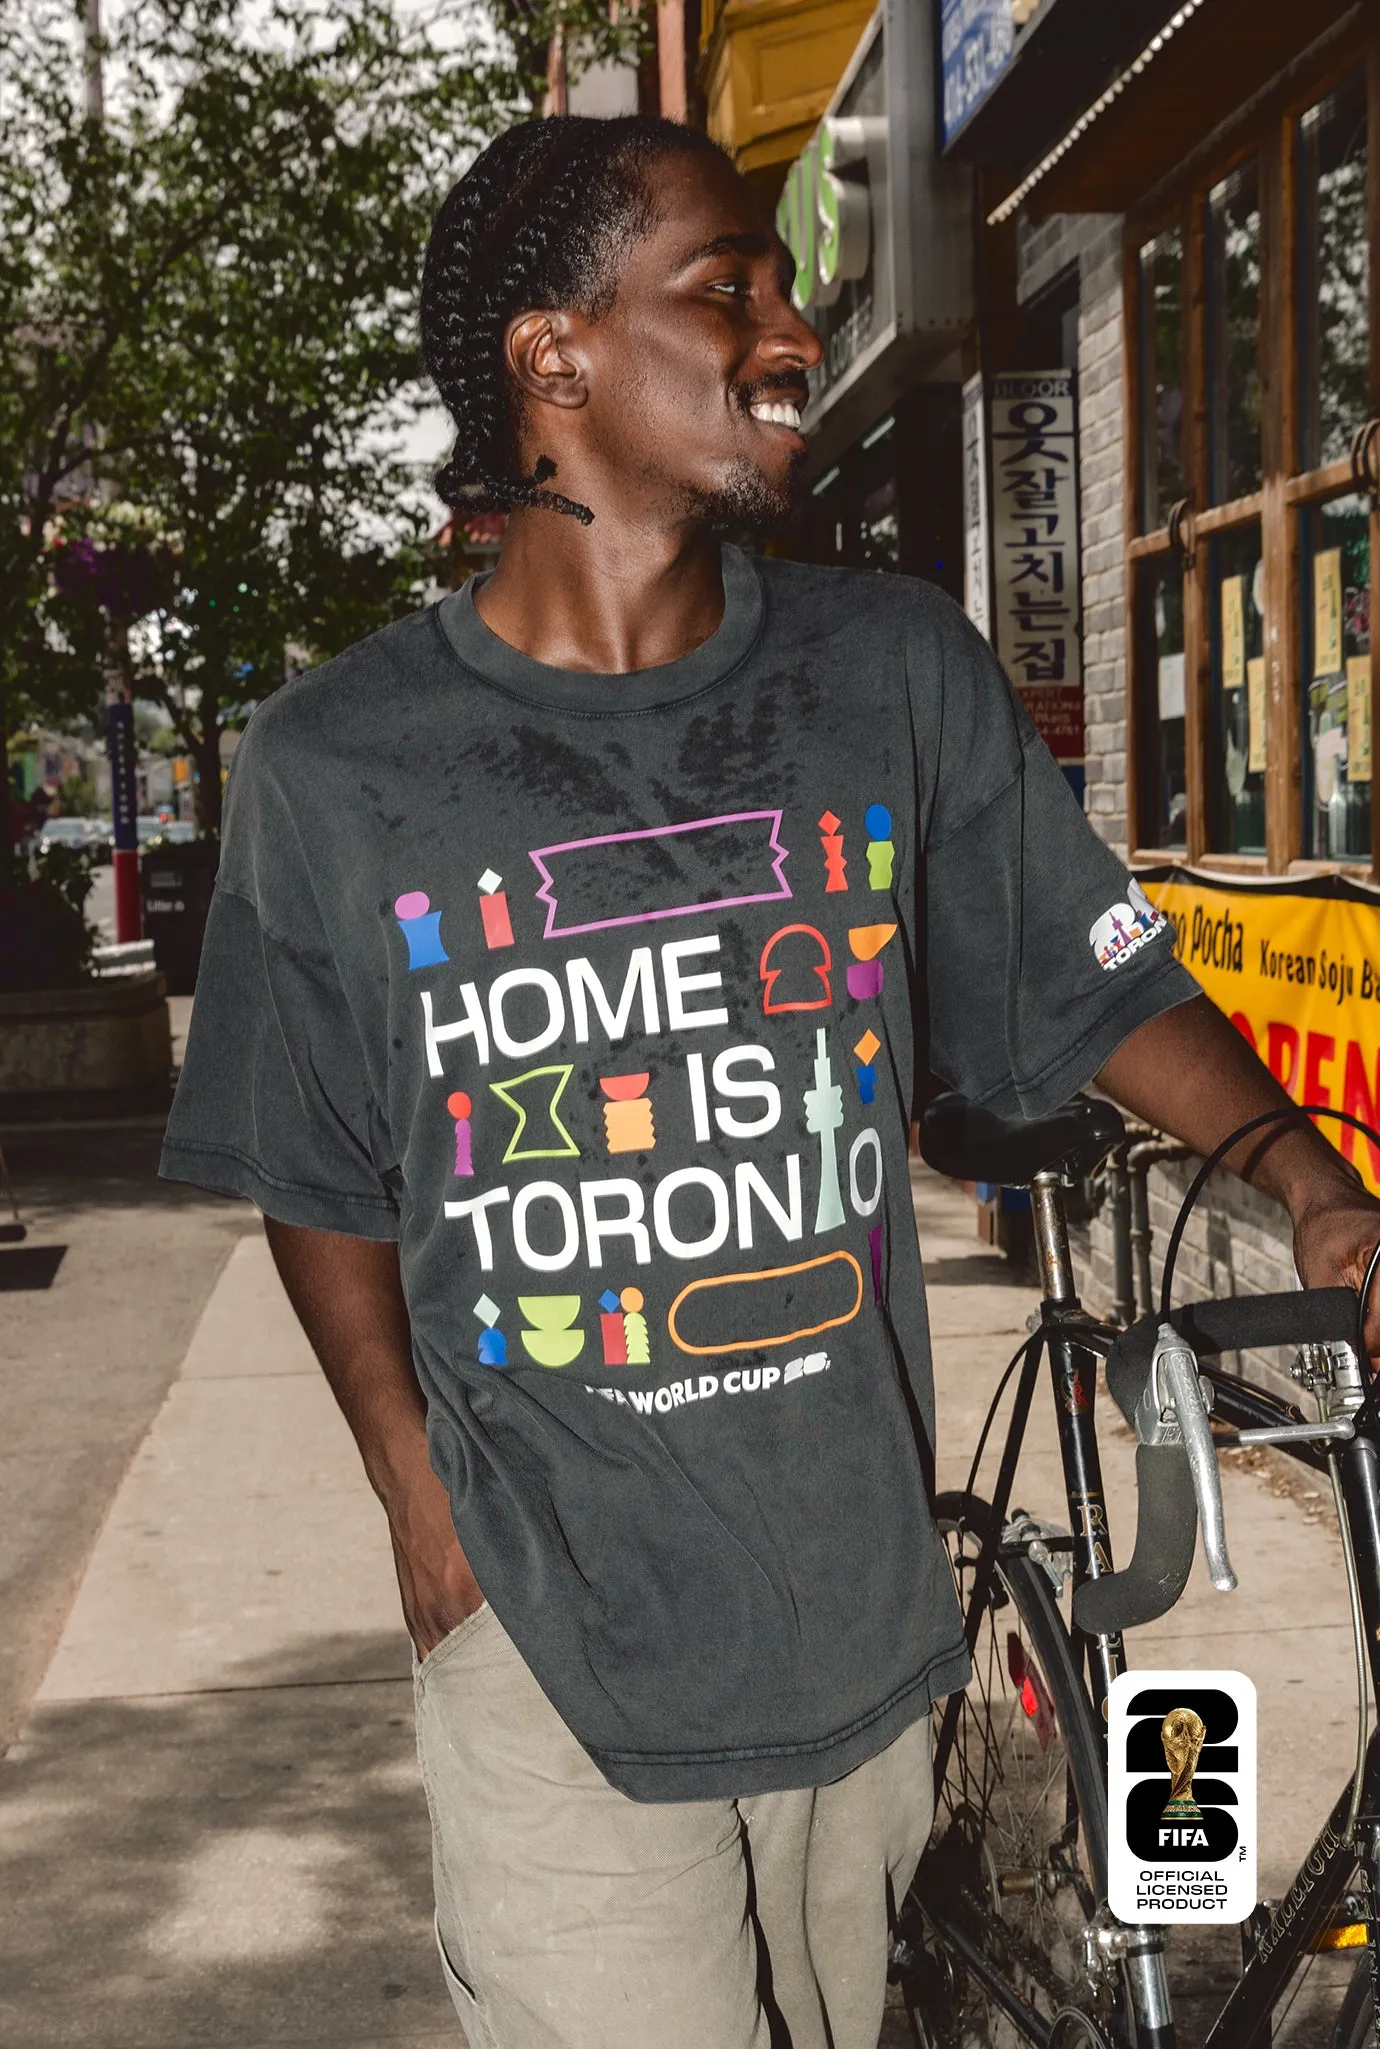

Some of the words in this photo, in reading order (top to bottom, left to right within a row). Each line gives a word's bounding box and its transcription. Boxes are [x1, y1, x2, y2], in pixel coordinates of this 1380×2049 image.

[992, 401, 1074, 683] 옷잘고치는집
[1189, 904, 1244, 974] Pocha
[1259, 939, 1316, 986] Korean
[1318, 948, 1354, 1006] Soju
[420, 935, 729, 1079] HOME
[686, 1044, 783, 1144] IS
[627, 1375, 719, 1416] WORLD
[722, 1366, 781, 1395] CUP
